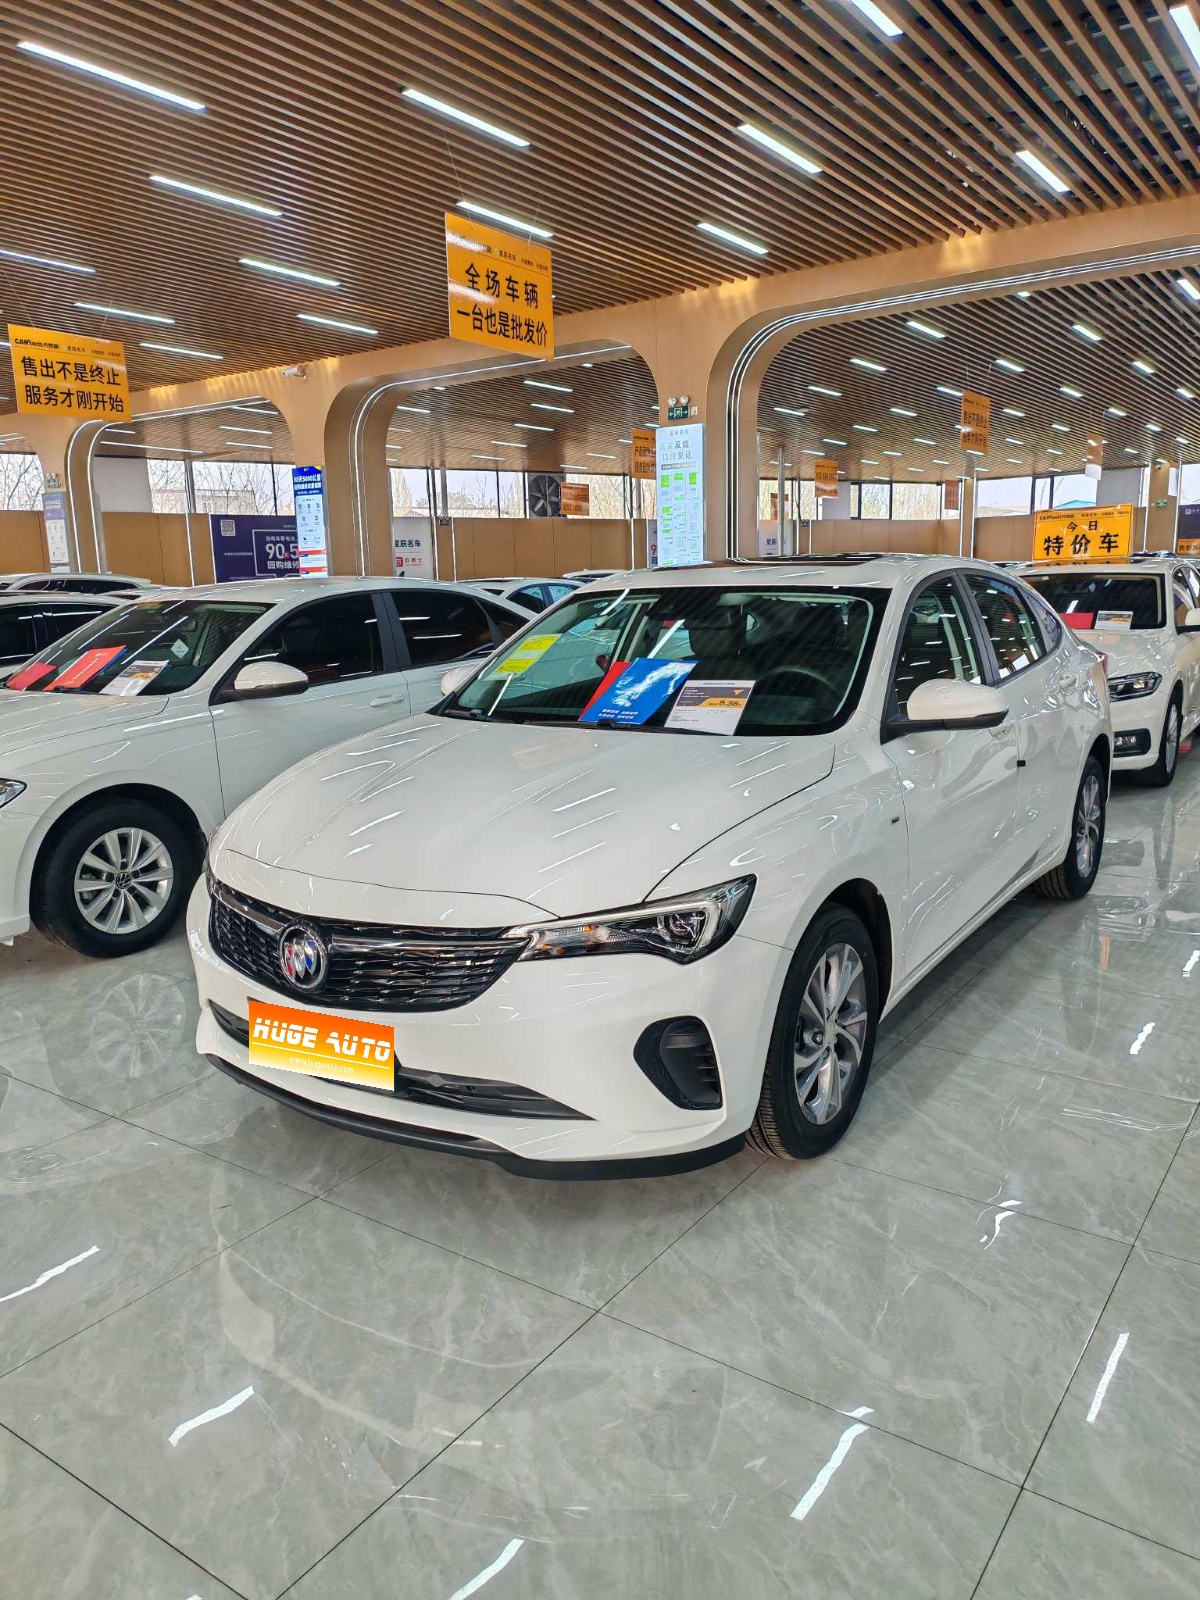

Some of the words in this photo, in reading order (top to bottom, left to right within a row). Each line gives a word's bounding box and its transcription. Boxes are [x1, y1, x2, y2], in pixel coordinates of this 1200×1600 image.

[465, 262, 539, 309] 全场车辆
[457, 303, 548, 347] 一台也是批发价
[21, 356, 121, 386] 售出不是终止
[25, 384, 124, 412] 服务才刚开始
[1067, 520, 1098, 532] 今日
[1043, 533, 1119, 556] 特价车
